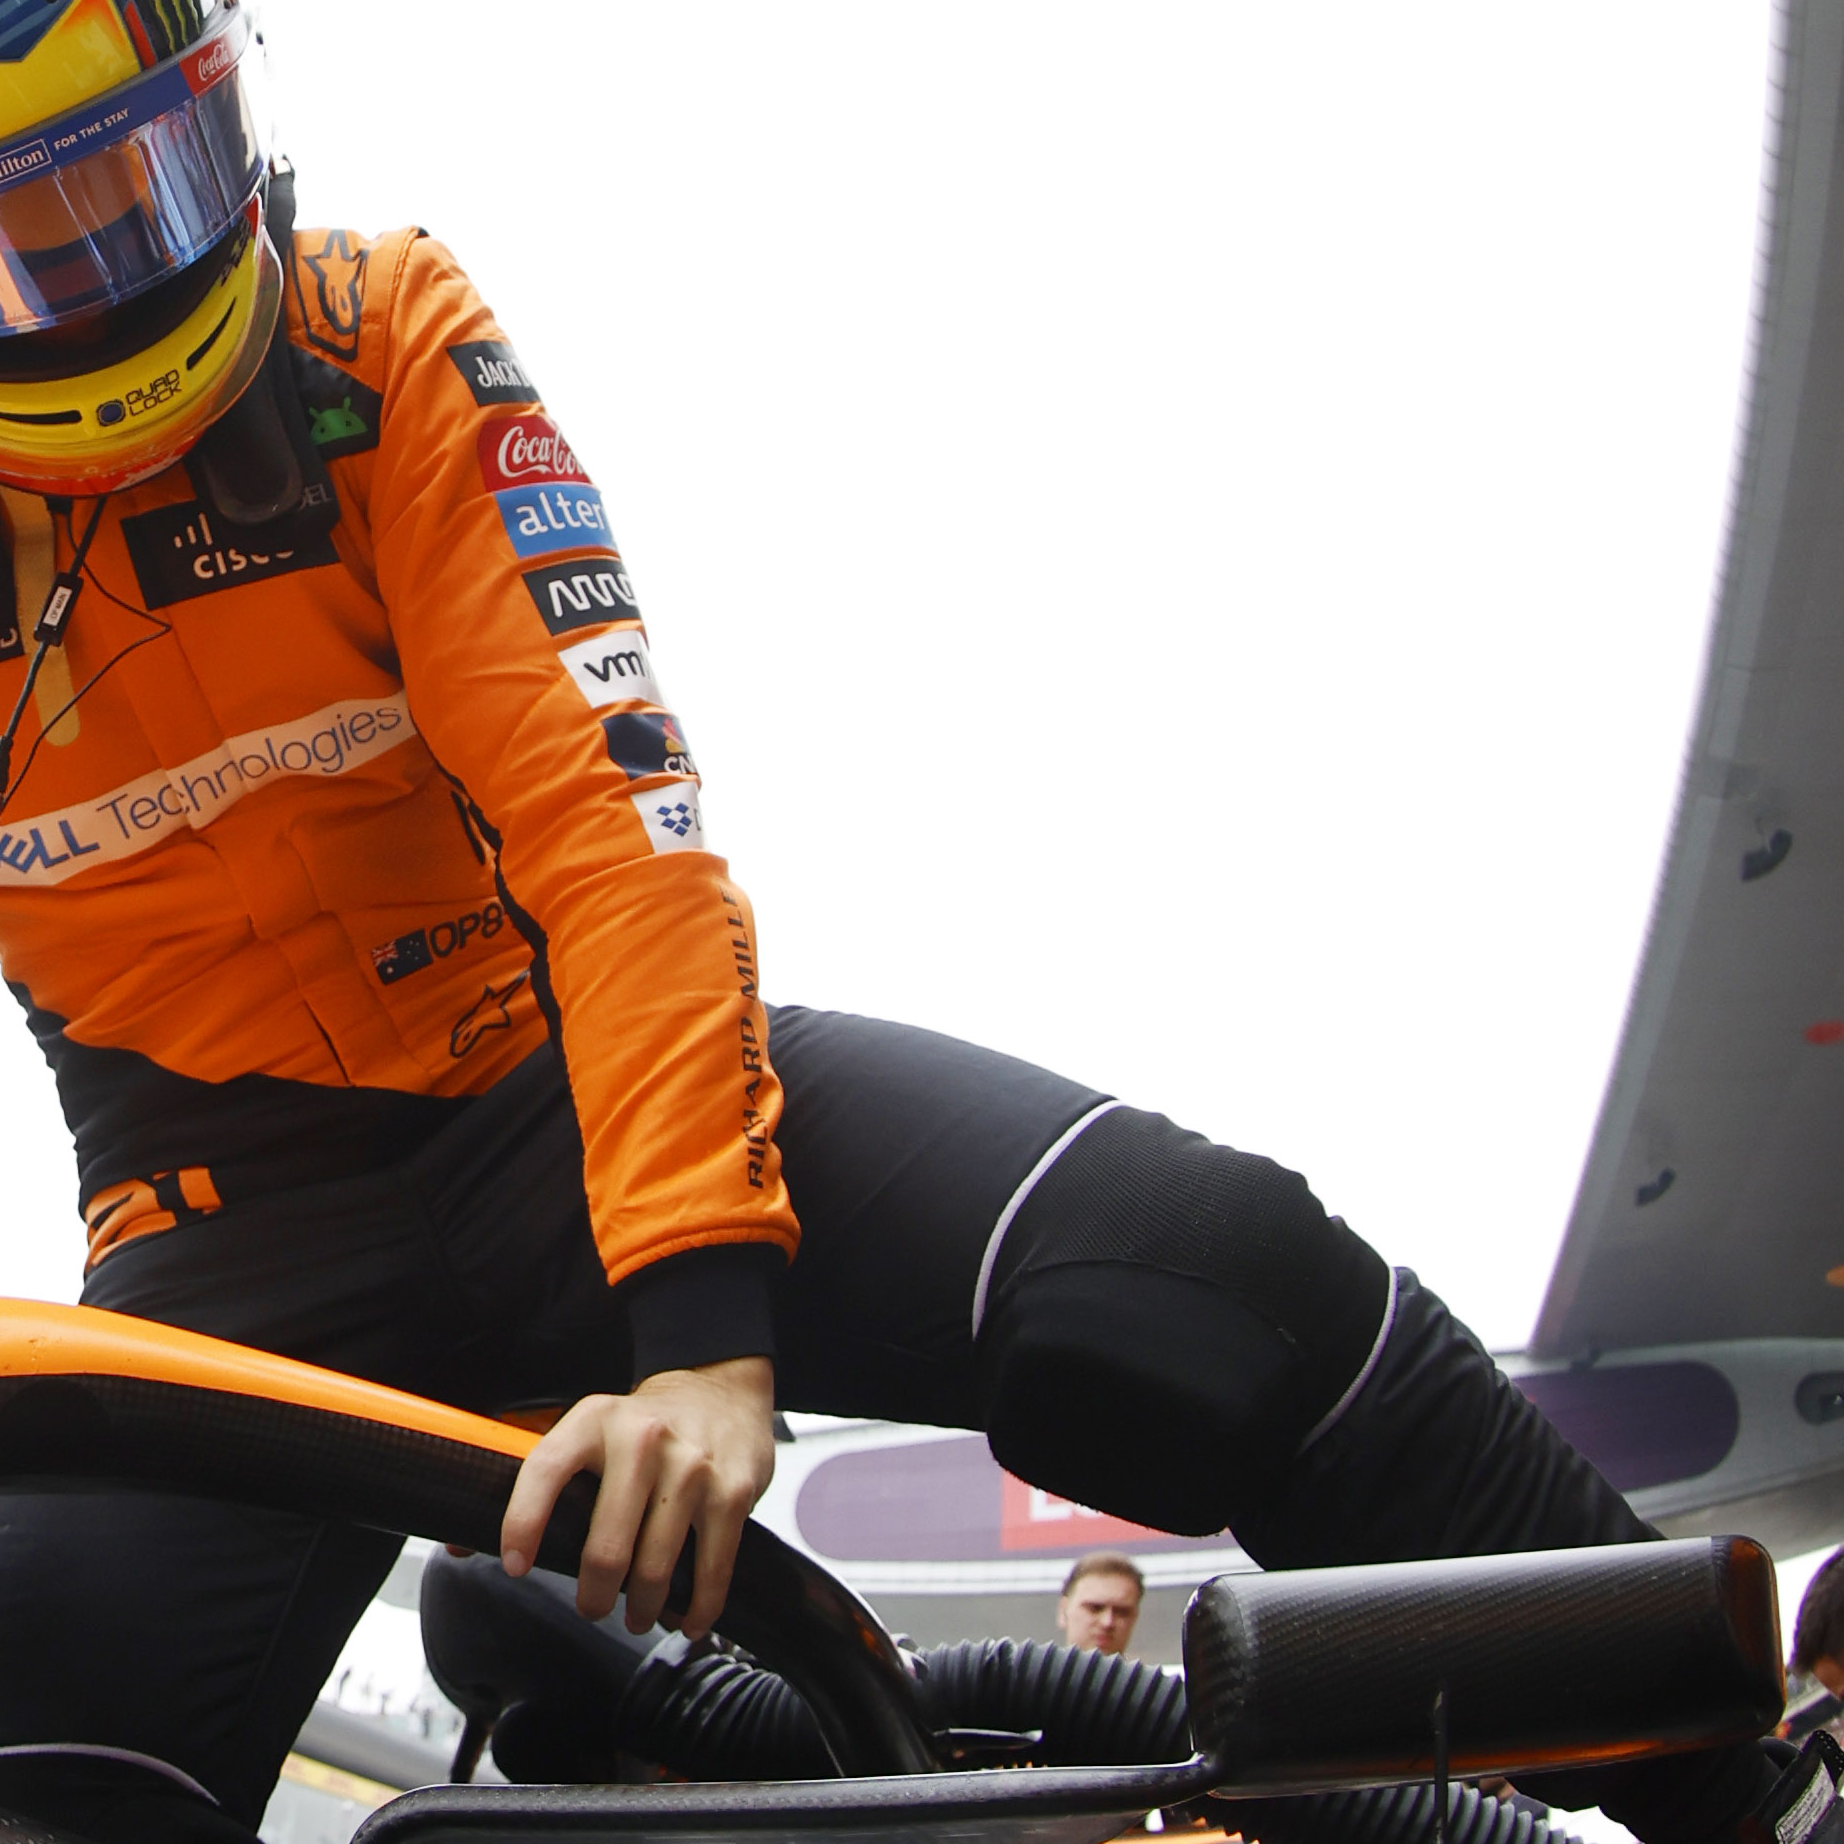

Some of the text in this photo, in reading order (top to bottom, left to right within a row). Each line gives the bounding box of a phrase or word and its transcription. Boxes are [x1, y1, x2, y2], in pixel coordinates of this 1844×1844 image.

[54, 132, 78, 151] FOR
[78, 122, 103, 141] THE
[104, 108, 130, 128] STAY
[125, 369, 180, 405] QUAD
[129, 383, 182, 416] LOCK
[96, 706, 403, 839] Technologies
